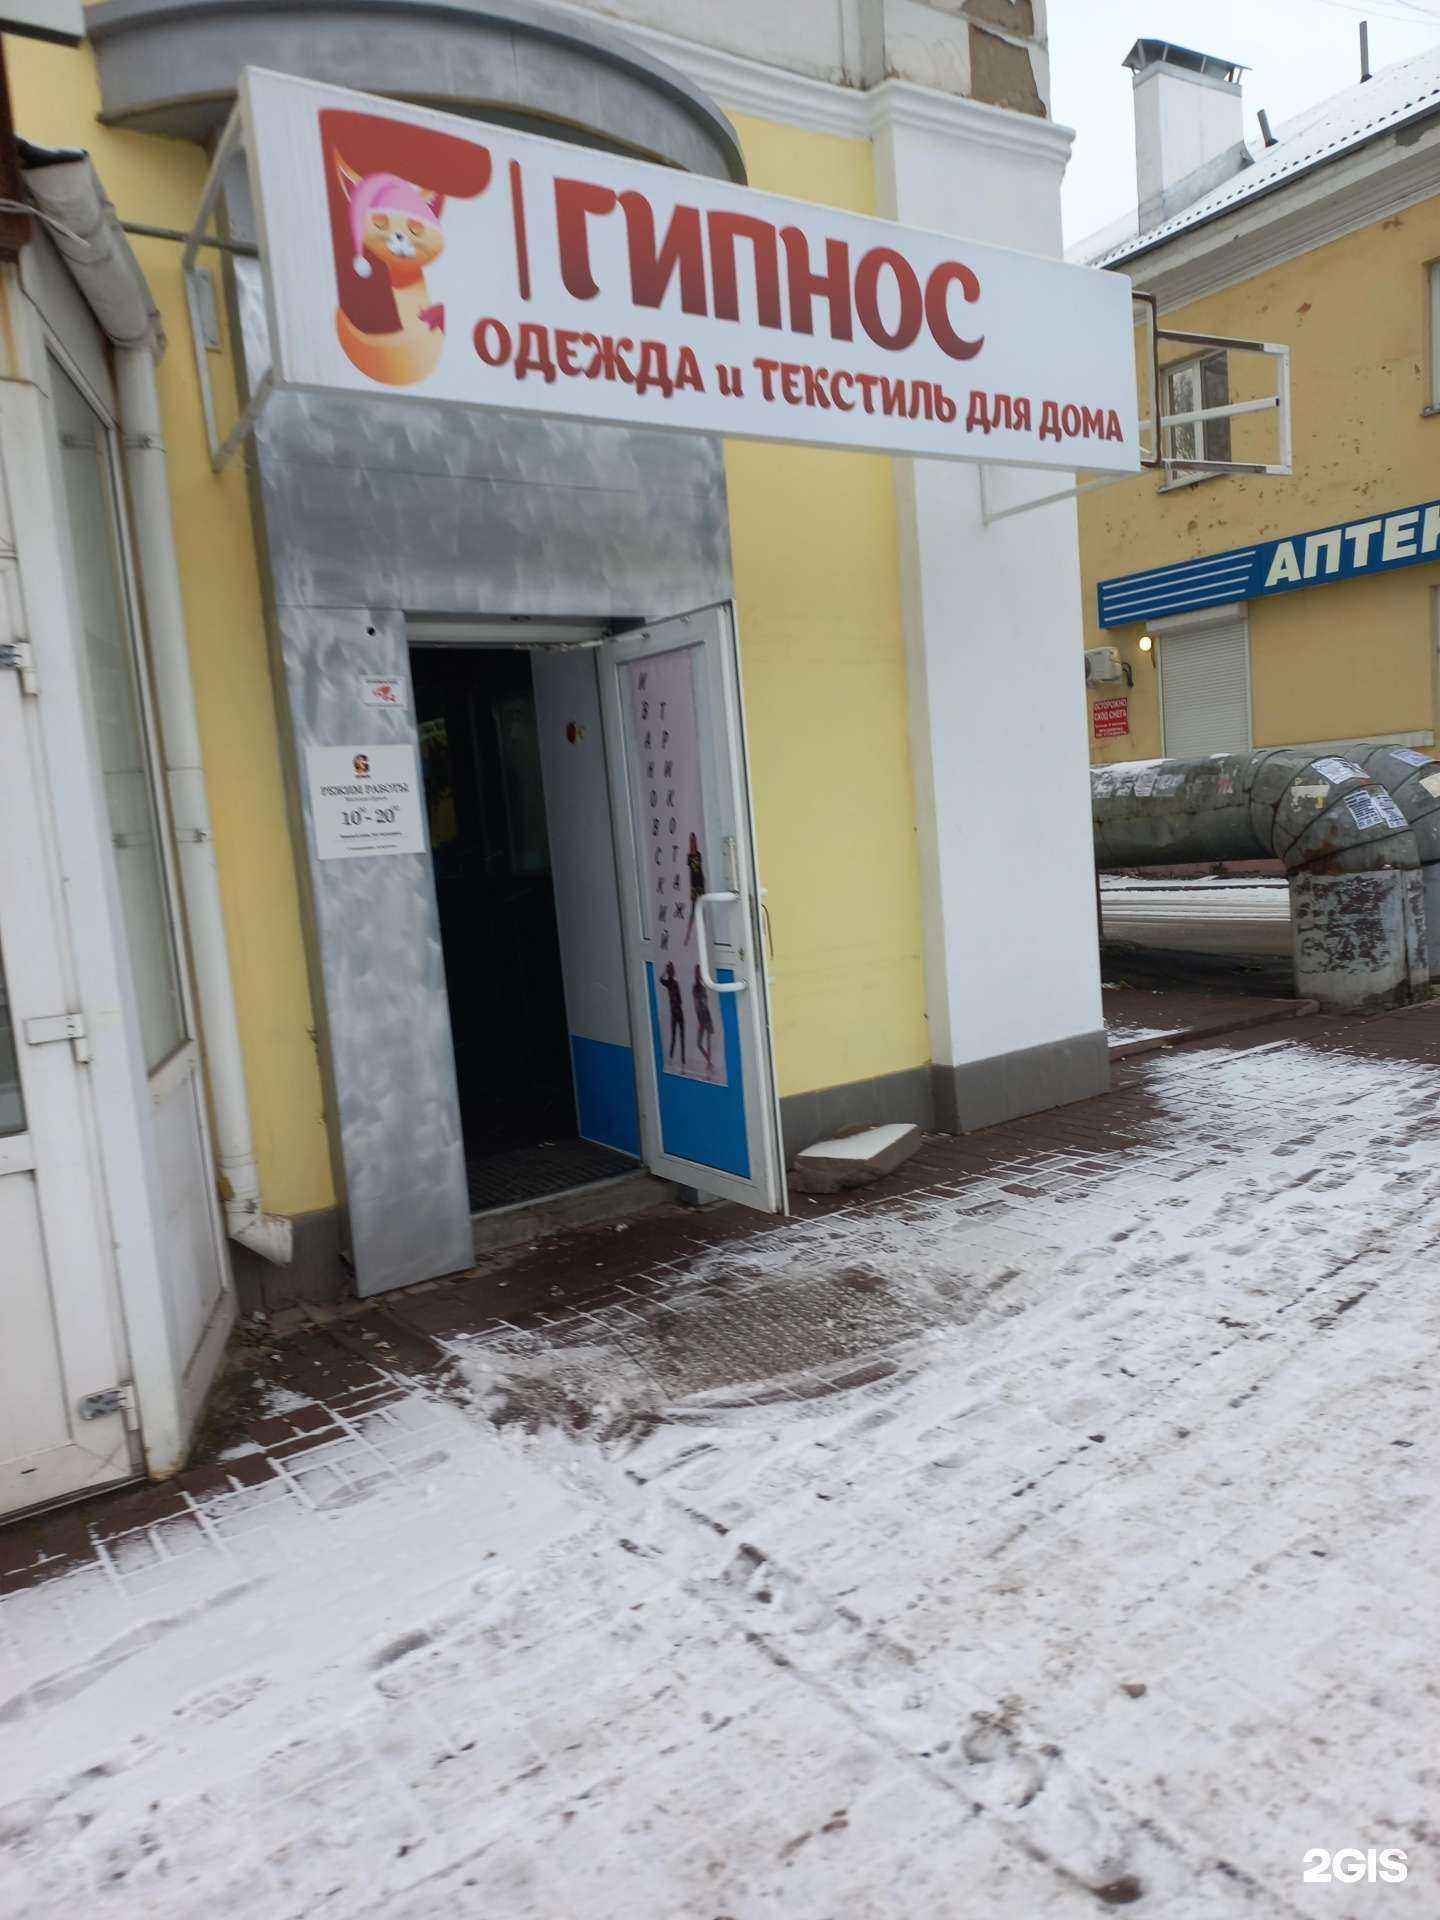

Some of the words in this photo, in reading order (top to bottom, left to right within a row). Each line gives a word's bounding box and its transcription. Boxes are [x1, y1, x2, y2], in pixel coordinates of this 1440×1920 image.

[553, 174, 986, 361] ГИПНОС
[472, 317, 706, 399] ОДЕЖДА
[753, 357, 958, 424] ТЕКСТИЛЬ
[964, 390, 1034, 443] ДЛЯ
[1038, 400, 1126, 444] ДОМА
